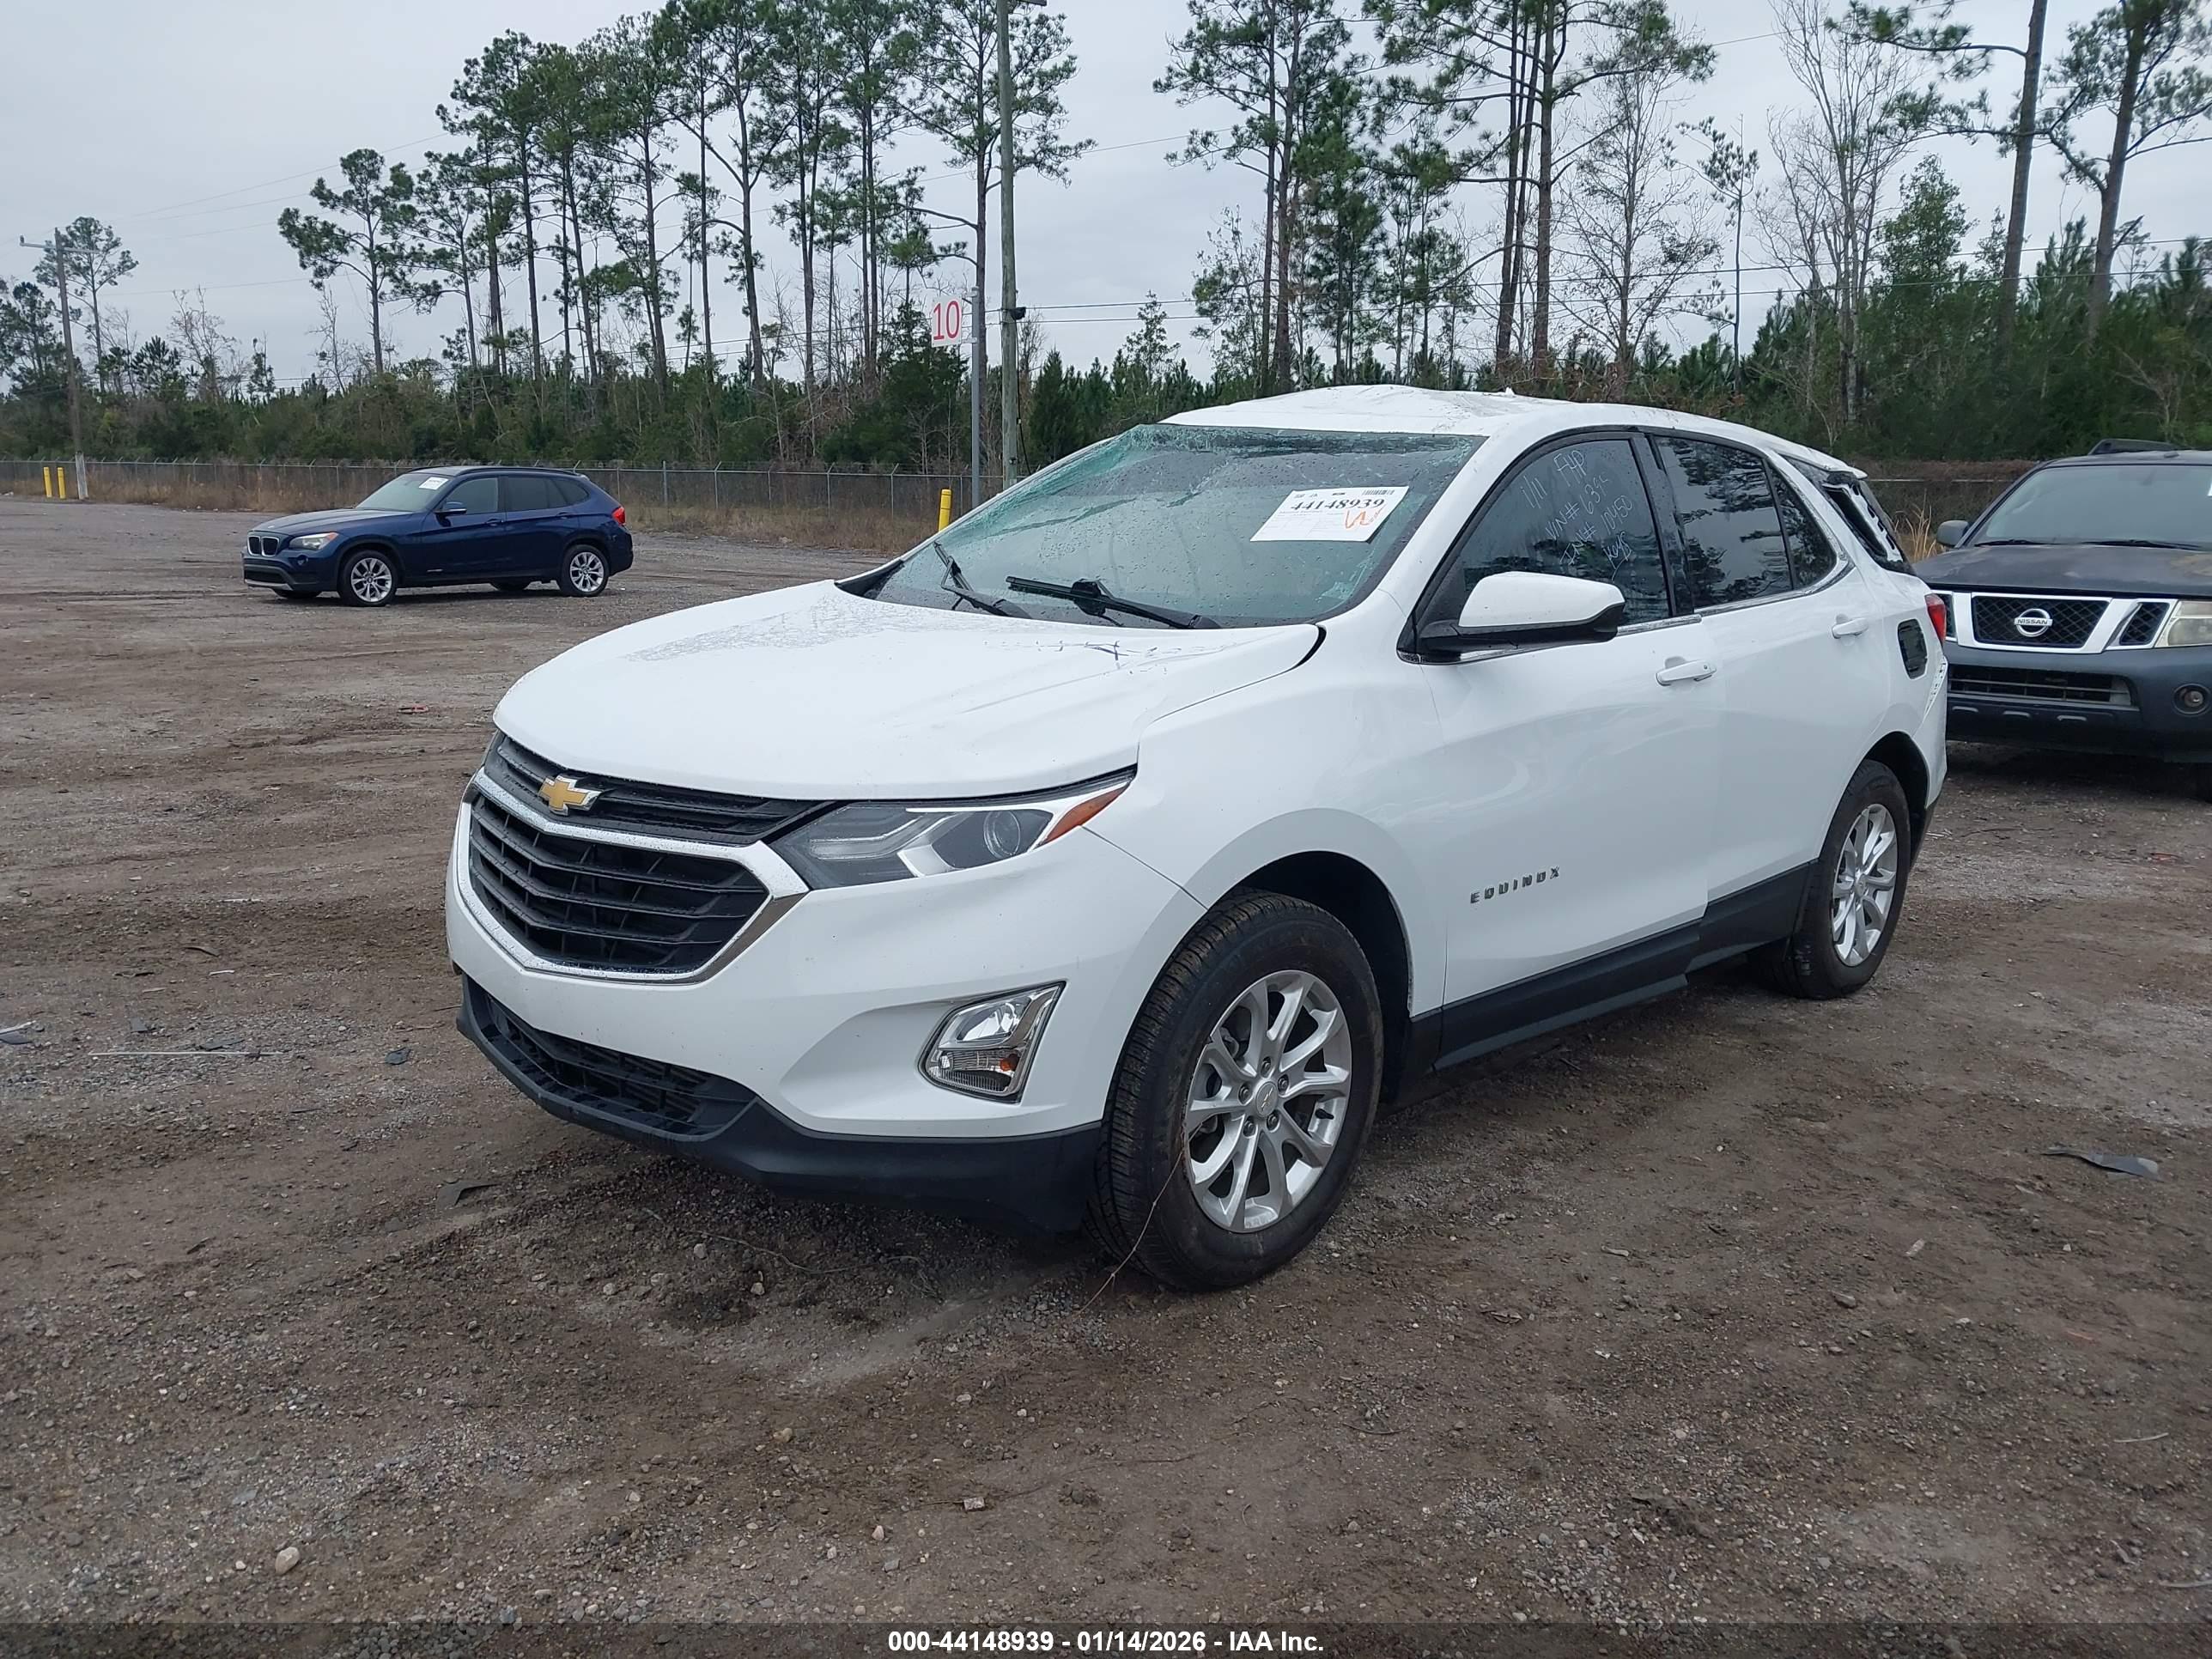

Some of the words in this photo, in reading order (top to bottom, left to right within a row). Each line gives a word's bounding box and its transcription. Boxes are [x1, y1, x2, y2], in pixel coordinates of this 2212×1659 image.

[933, 301, 960, 340] 10
[1291, 498, 1385, 510] 44148939
[1469, 866, 1560, 904] EQUINOX
